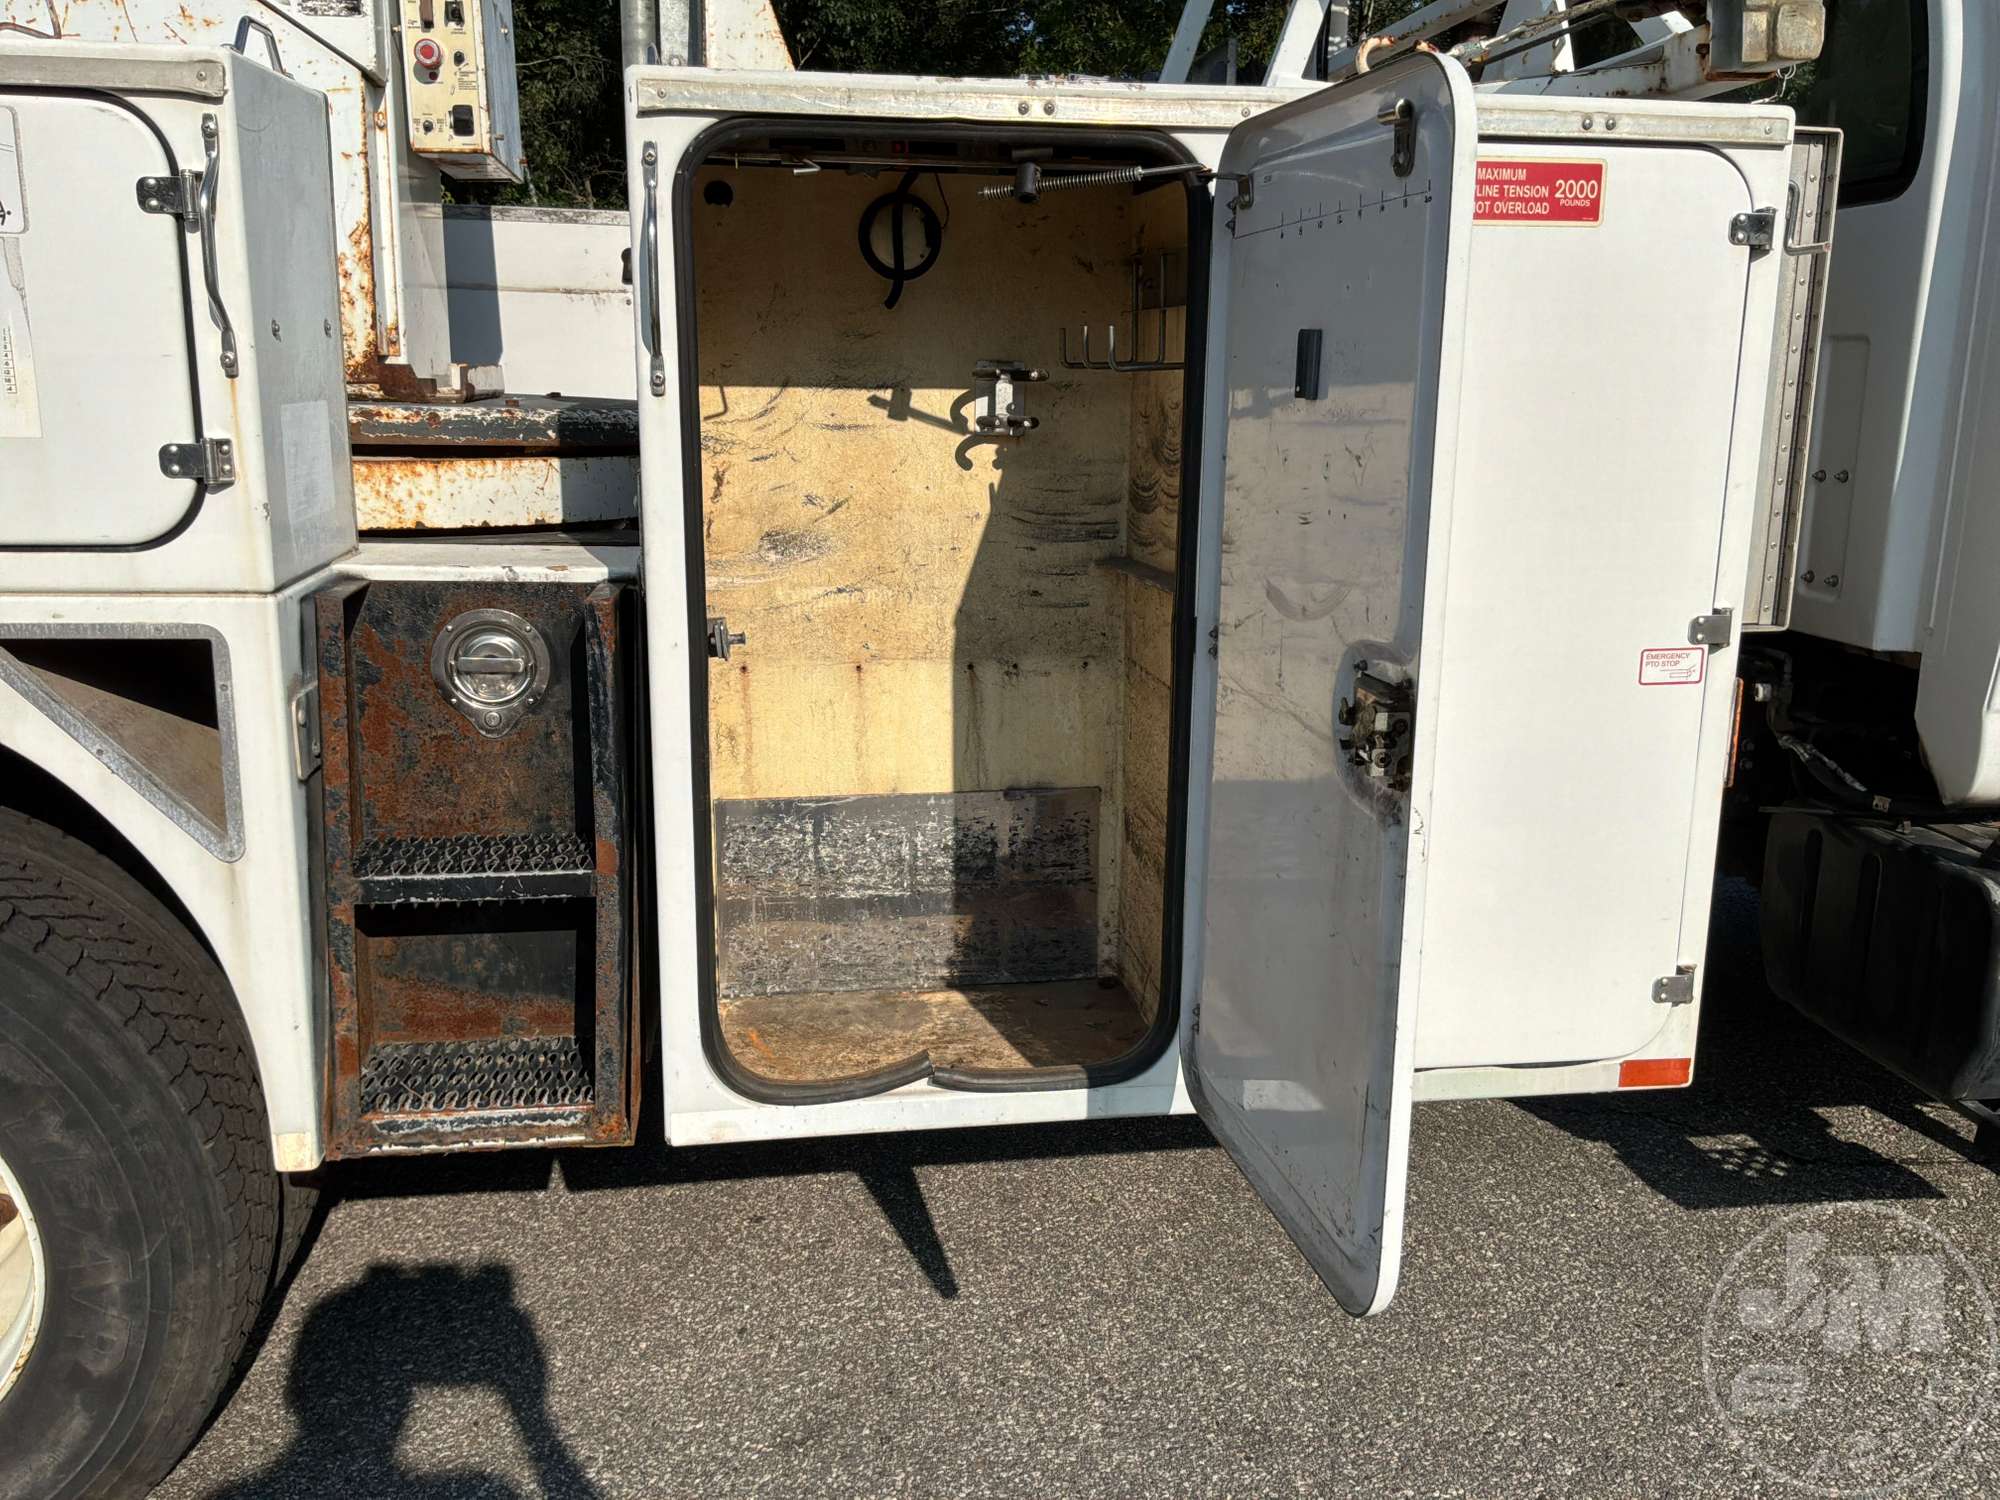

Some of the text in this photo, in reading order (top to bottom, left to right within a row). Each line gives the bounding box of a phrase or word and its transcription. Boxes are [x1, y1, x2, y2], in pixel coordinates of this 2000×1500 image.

[1477, 167, 1527, 181] MAXIMUM
[1476, 184, 1549, 198] LINE TENSION
[1554, 179, 1599, 199] 2000
[1474, 200, 1550, 215] OT OVERLOAD
[1559, 198, 1591, 207] POUNDS
[1645, 652, 1690, 660] EMERGENCY
[1645, 660, 1660, 668] PTO
